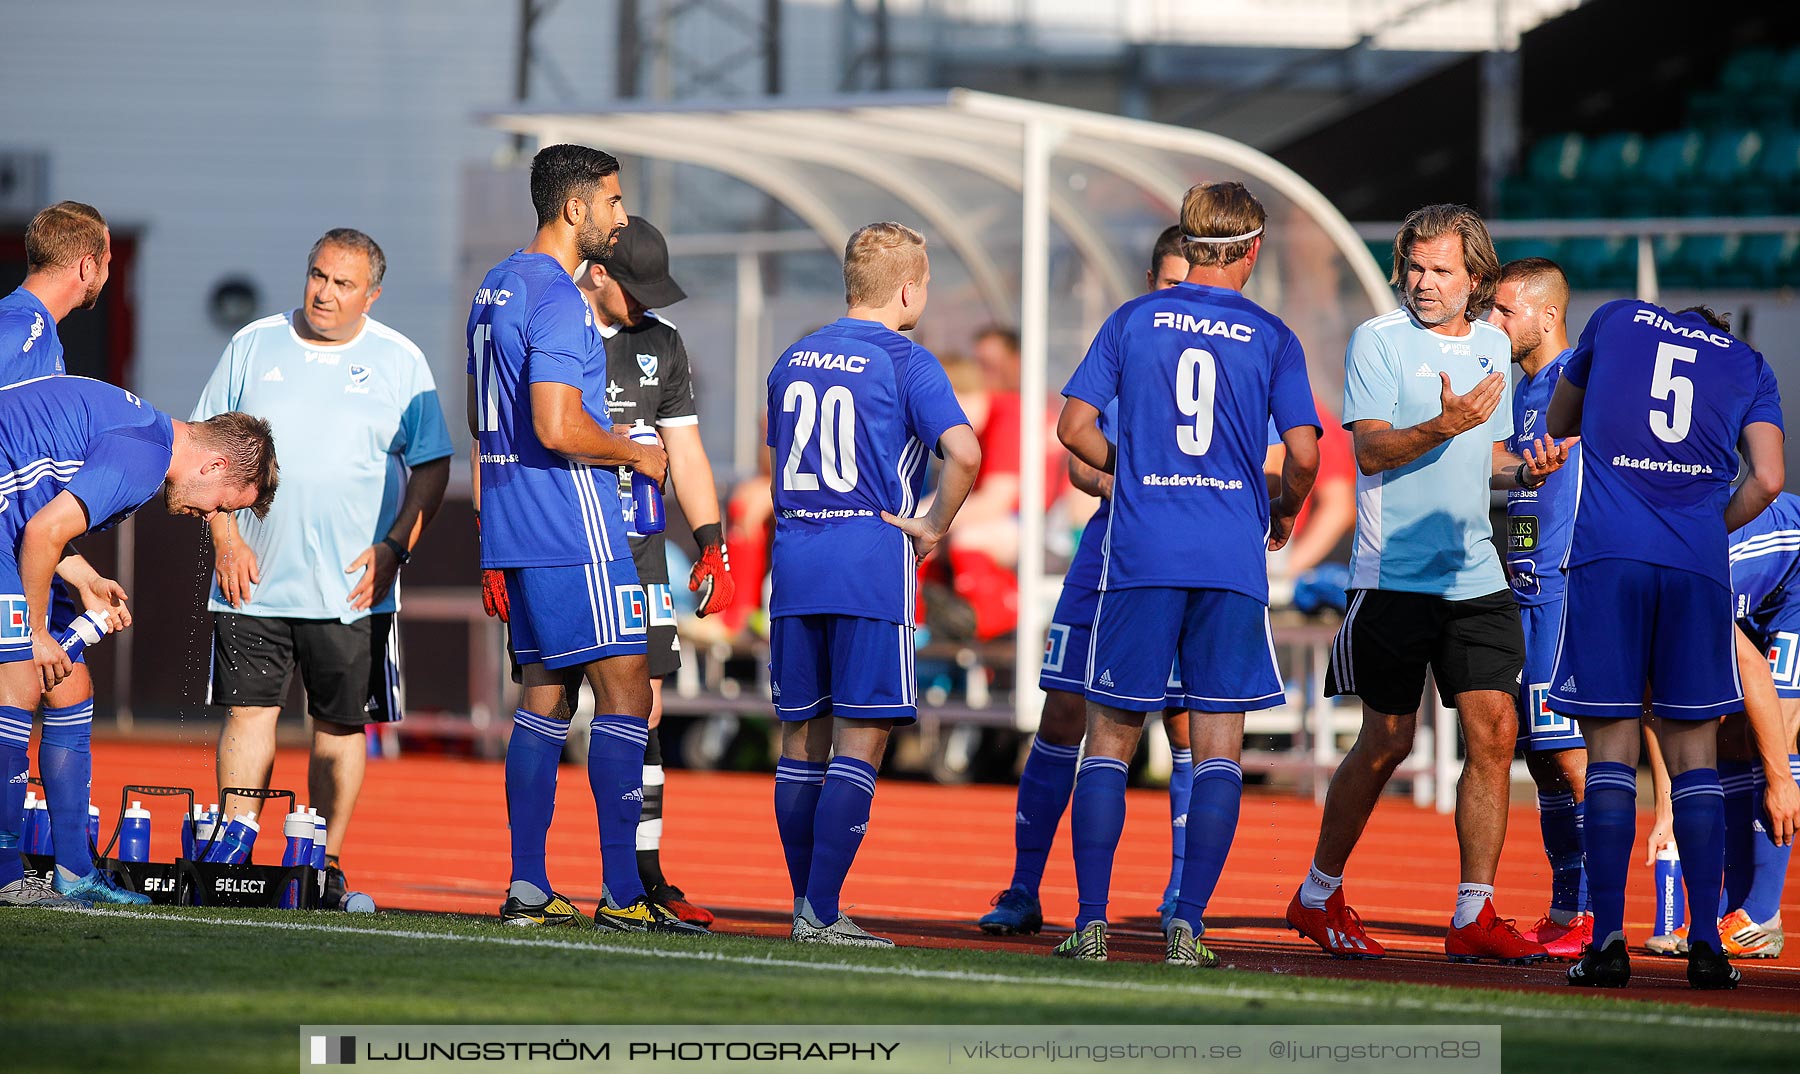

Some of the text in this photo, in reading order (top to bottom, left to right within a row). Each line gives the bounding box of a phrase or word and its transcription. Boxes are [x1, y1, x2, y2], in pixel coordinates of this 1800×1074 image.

[1175, 347, 1217, 456] 9
[1649, 341, 1698, 443] 5
[782, 380, 859, 493] 20
[1142, 474, 1243, 490] skadevicup.se
[214, 877, 266, 894] SELECT
[1664, 874, 1675, 932] INTERSPORT
